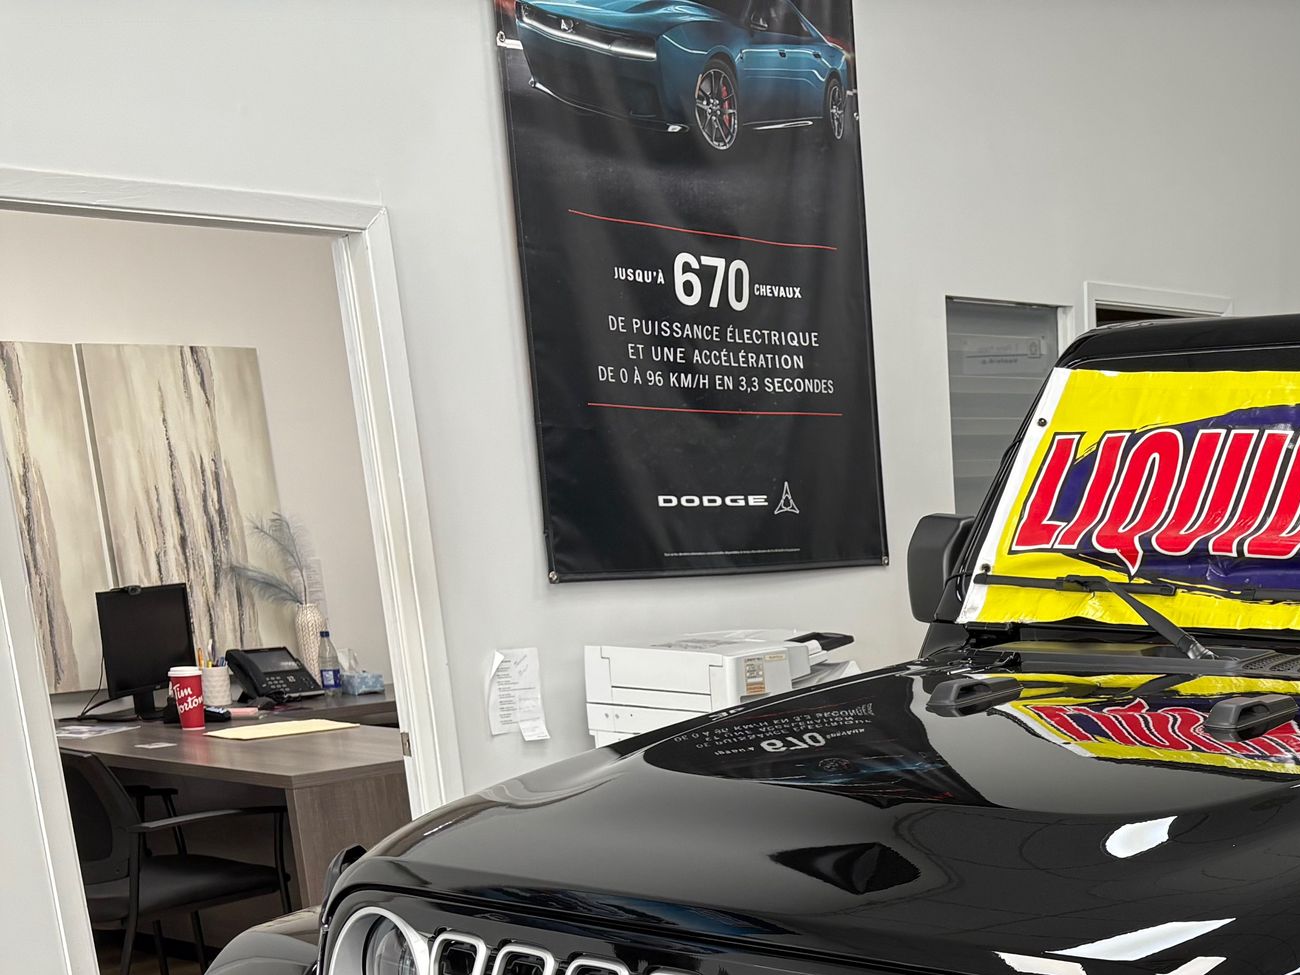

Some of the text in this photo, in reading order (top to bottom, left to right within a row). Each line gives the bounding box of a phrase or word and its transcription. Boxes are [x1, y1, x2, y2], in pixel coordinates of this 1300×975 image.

[613, 252, 802, 312] JUSQU'À 670 CHEVAUX
[608, 314, 820, 347] DE PUISSANCE ÉLECTRIQUE
[627, 343, 805, 370] ET UNE ACCÉLÉRATION
[597, 365, 835, 394] DE 0 À 96 KM/H EN 3,3 SECONDES
[657, 494, 769, 507] DODGE
[173, 684, 192, 700] Tim
[178, 696, 203, 713] orton
